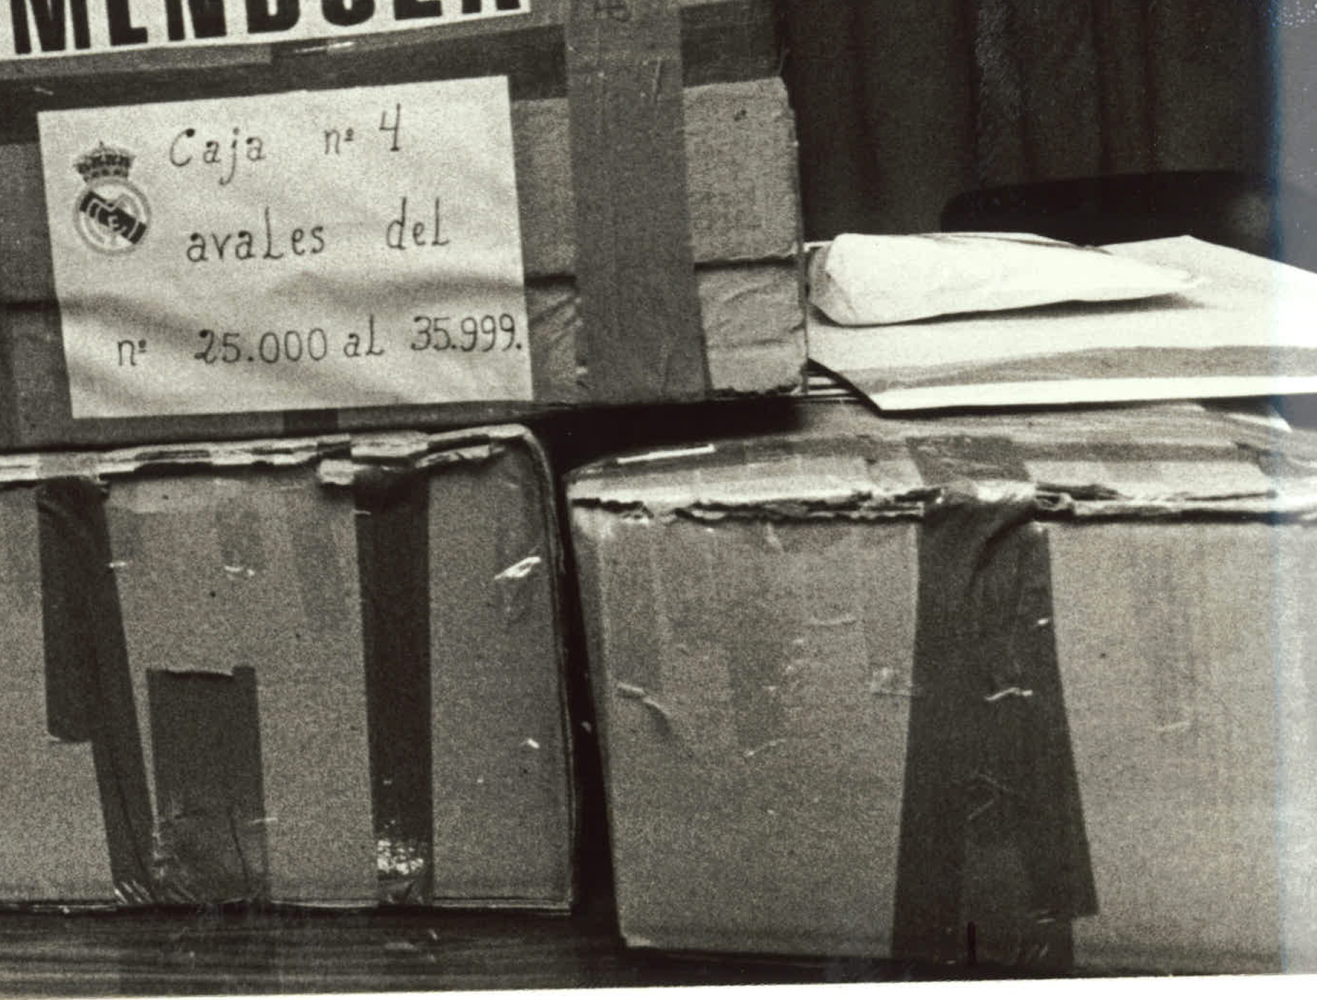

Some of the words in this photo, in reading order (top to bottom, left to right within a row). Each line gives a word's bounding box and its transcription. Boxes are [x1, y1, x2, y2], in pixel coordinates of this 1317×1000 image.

[168, 126, 265, 187] Caja
[377, 102, 402, 152] 4
[192, 327, 328, 364] 25.000
